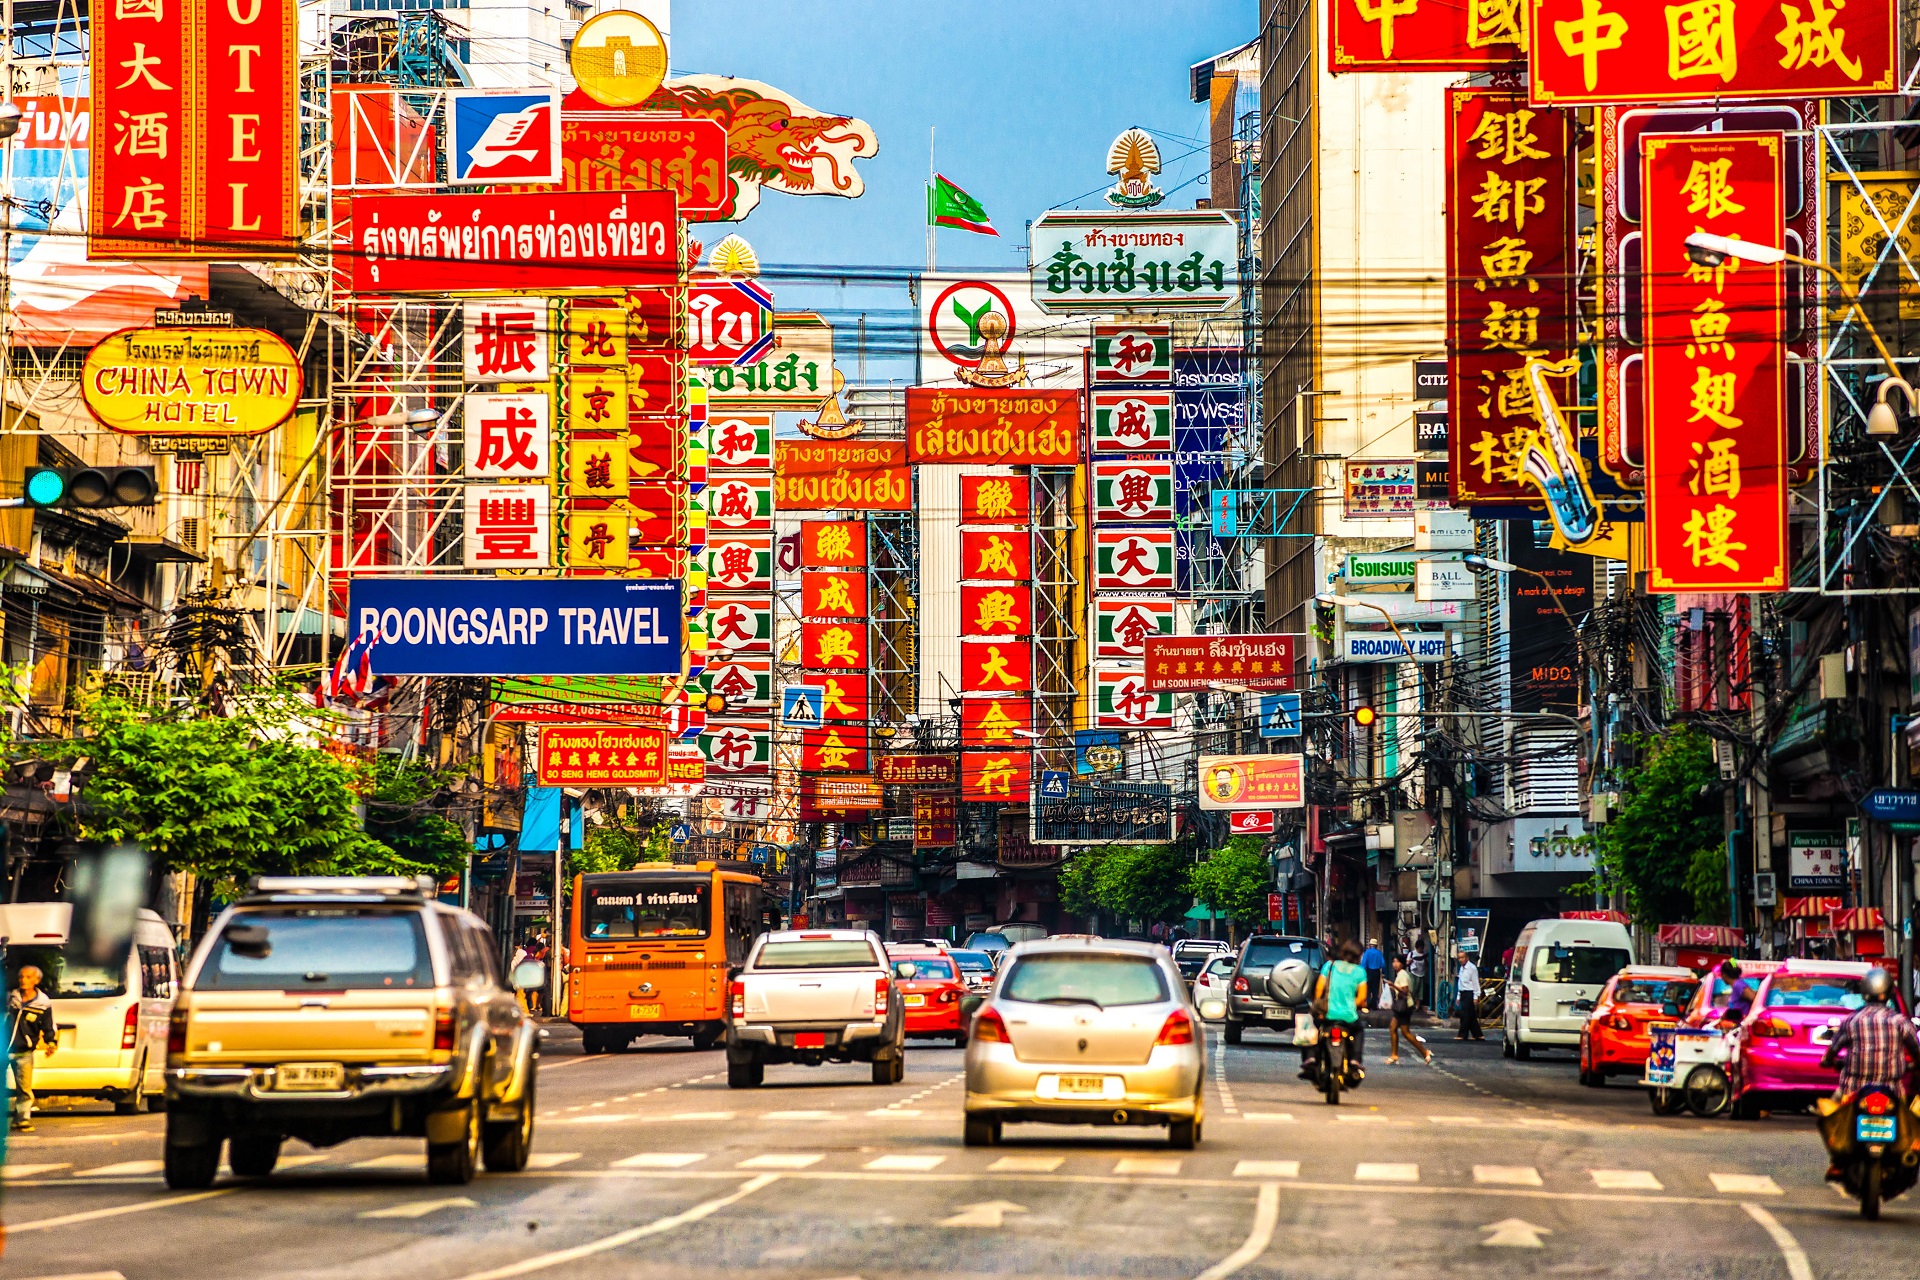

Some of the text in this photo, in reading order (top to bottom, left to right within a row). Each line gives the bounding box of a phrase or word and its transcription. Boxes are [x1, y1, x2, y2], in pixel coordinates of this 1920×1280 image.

[1553, 0, 1864, 92] 中國城
[362, 194, 667, 284] รุ่งทรัพย์การท่องเที่ยว
[1084, 229, 1184, 247] ห้างขายทอง
[95, 366, 289, 397] CHINA TOWN
[931, 391, 1057, 414] ห้างขายทอง
[145, 402, 237, 424] HOTEL
[474, 311, 539, 561] 振成豐
[1419, 423, 1449, 435] RA
[1109, 333, 1158, 721] 和成興大金行
[1432, 572, 1461, 580] BALL
[712, 424, 756, 771] 和成興大金行
[1517, 587, 1523, 595] A
[1524, 586, 1539, 596] mark
[1564, 585, 1585, 597] design
[359, 606, 669, 645] ROONGSARP TRAVEL
[972, 480, 1022, 798] 聯成興大金行
[1351, 640, 1456, 655] BROADWAY HOTL
[1153, 645, 1204, 656] ร้านขายยา
[812, 523, 860, 817] 聯成興大金
[1153, 680, 1165, 688] LIM
[1168, 679, 1189, 688] SOON
[1250, 677, 1287, 687] MEDICINE
[543, 690, 574, 699] THAI
[547, 769, 660, 779] SO SENG HENG GOLDSMITH
[1874, 795, 1917, 805] เยาวราช
[1803, 848, 1832, 860] 中國
